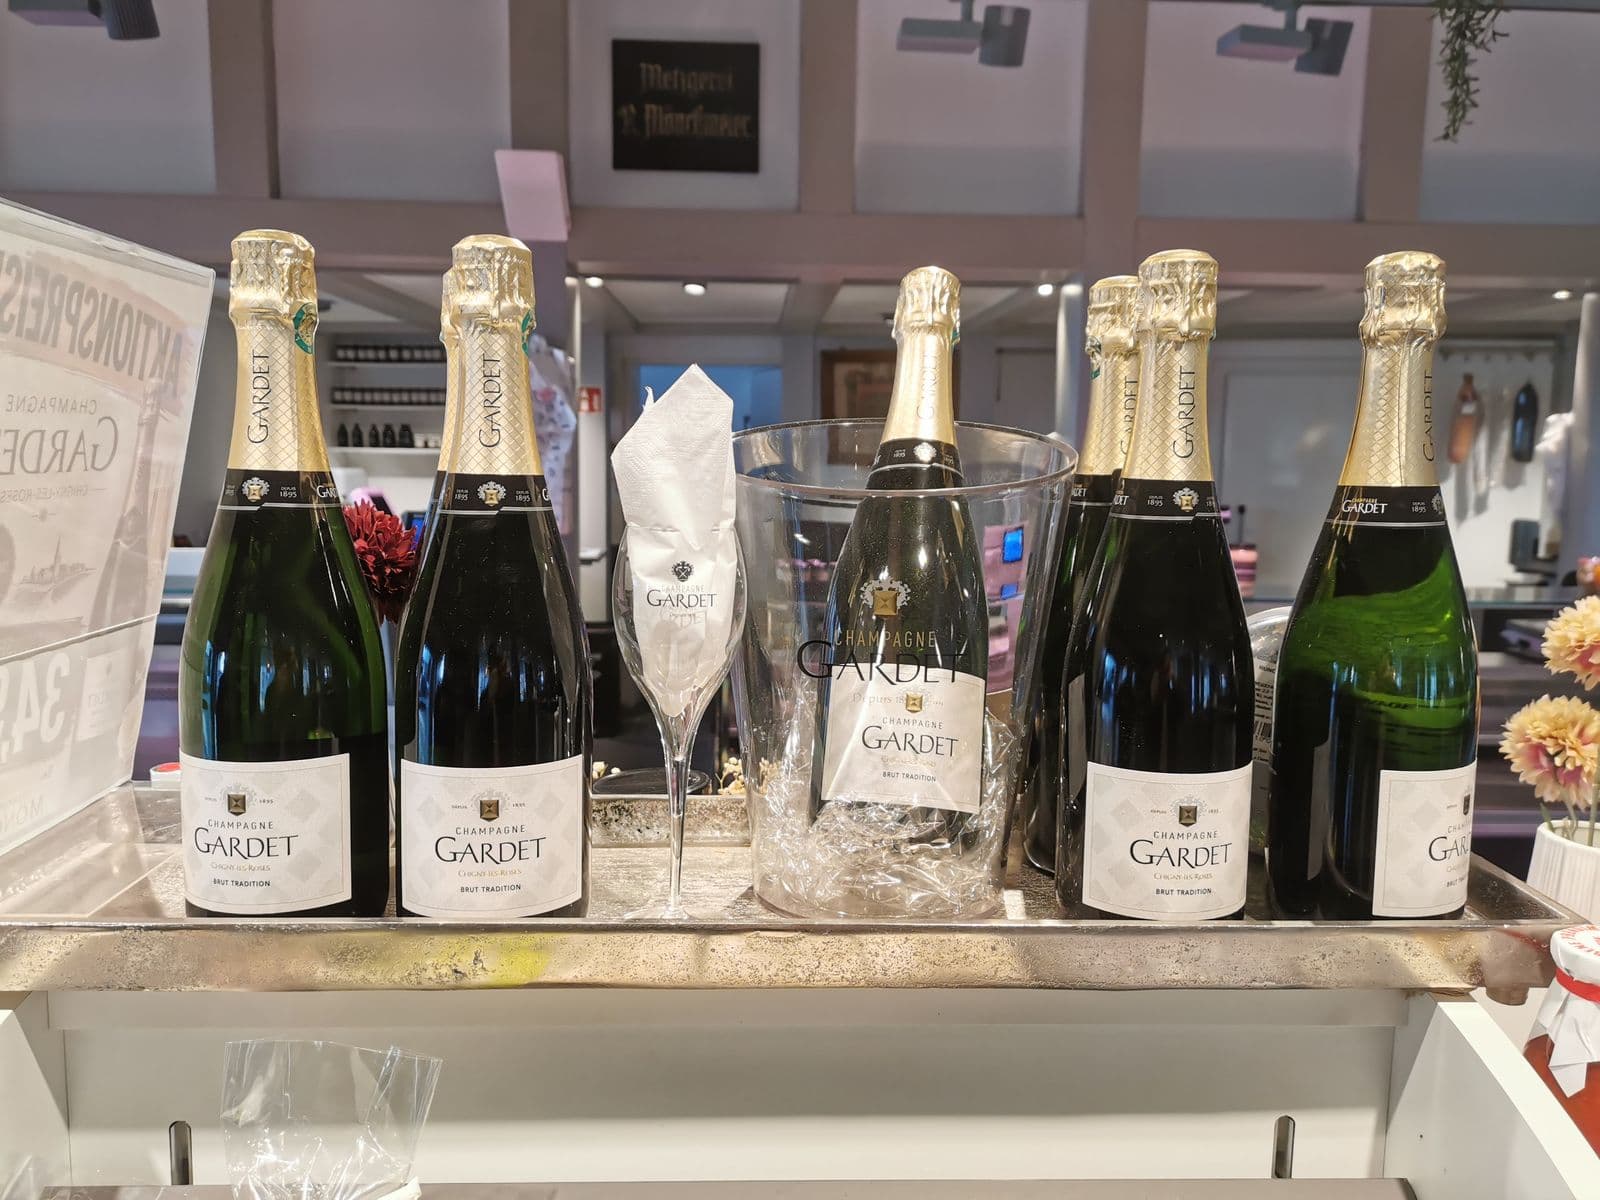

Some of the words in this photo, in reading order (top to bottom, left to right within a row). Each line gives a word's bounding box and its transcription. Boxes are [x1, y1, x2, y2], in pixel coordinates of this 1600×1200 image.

[247, 350, 272, 444] GARDET
[478, 352, 503, 448] GARDET
[1172, 365, 1196, 459] GARDET
[1422, 368, 1436, 462] GARDET
[1341, 500, 1388, 514] GARDET
[646, 589, 718, 609] GARDET
[834, 630, 936, 648] CHAMPAGNE
[796, 640, 968, 686] GARDET
[882, 716, 944, 730] CHAMPAGNE
[861, 725, 960, 758] GARDET
[882, 770, 900, 779] BRUT
[901, 772, 937, 783] TRADITION
[207, 818, 274, 831] CHAMPAGNE
[455, 824, 526, 836] CHAMPAGNE
[194, 827, 299, 860] GARDET
[1153, 830, 1219, 841] CHAMPAGNE
[434, 836, 547, 865] GARDET
[1129, 838, 1233, 869] GARDET
[1428, 836, 1470, 862] GAR
[213, 877, 229, 887] BRUT
[231, 879, 271, 888] TRADITION
[460, 886, 479, 894] BRUT
[481, 883, 521, 894] TRADITION
[1155, 887, 1174, 896] BRUT
[1176, 887, 1212, 897] TRADITION
